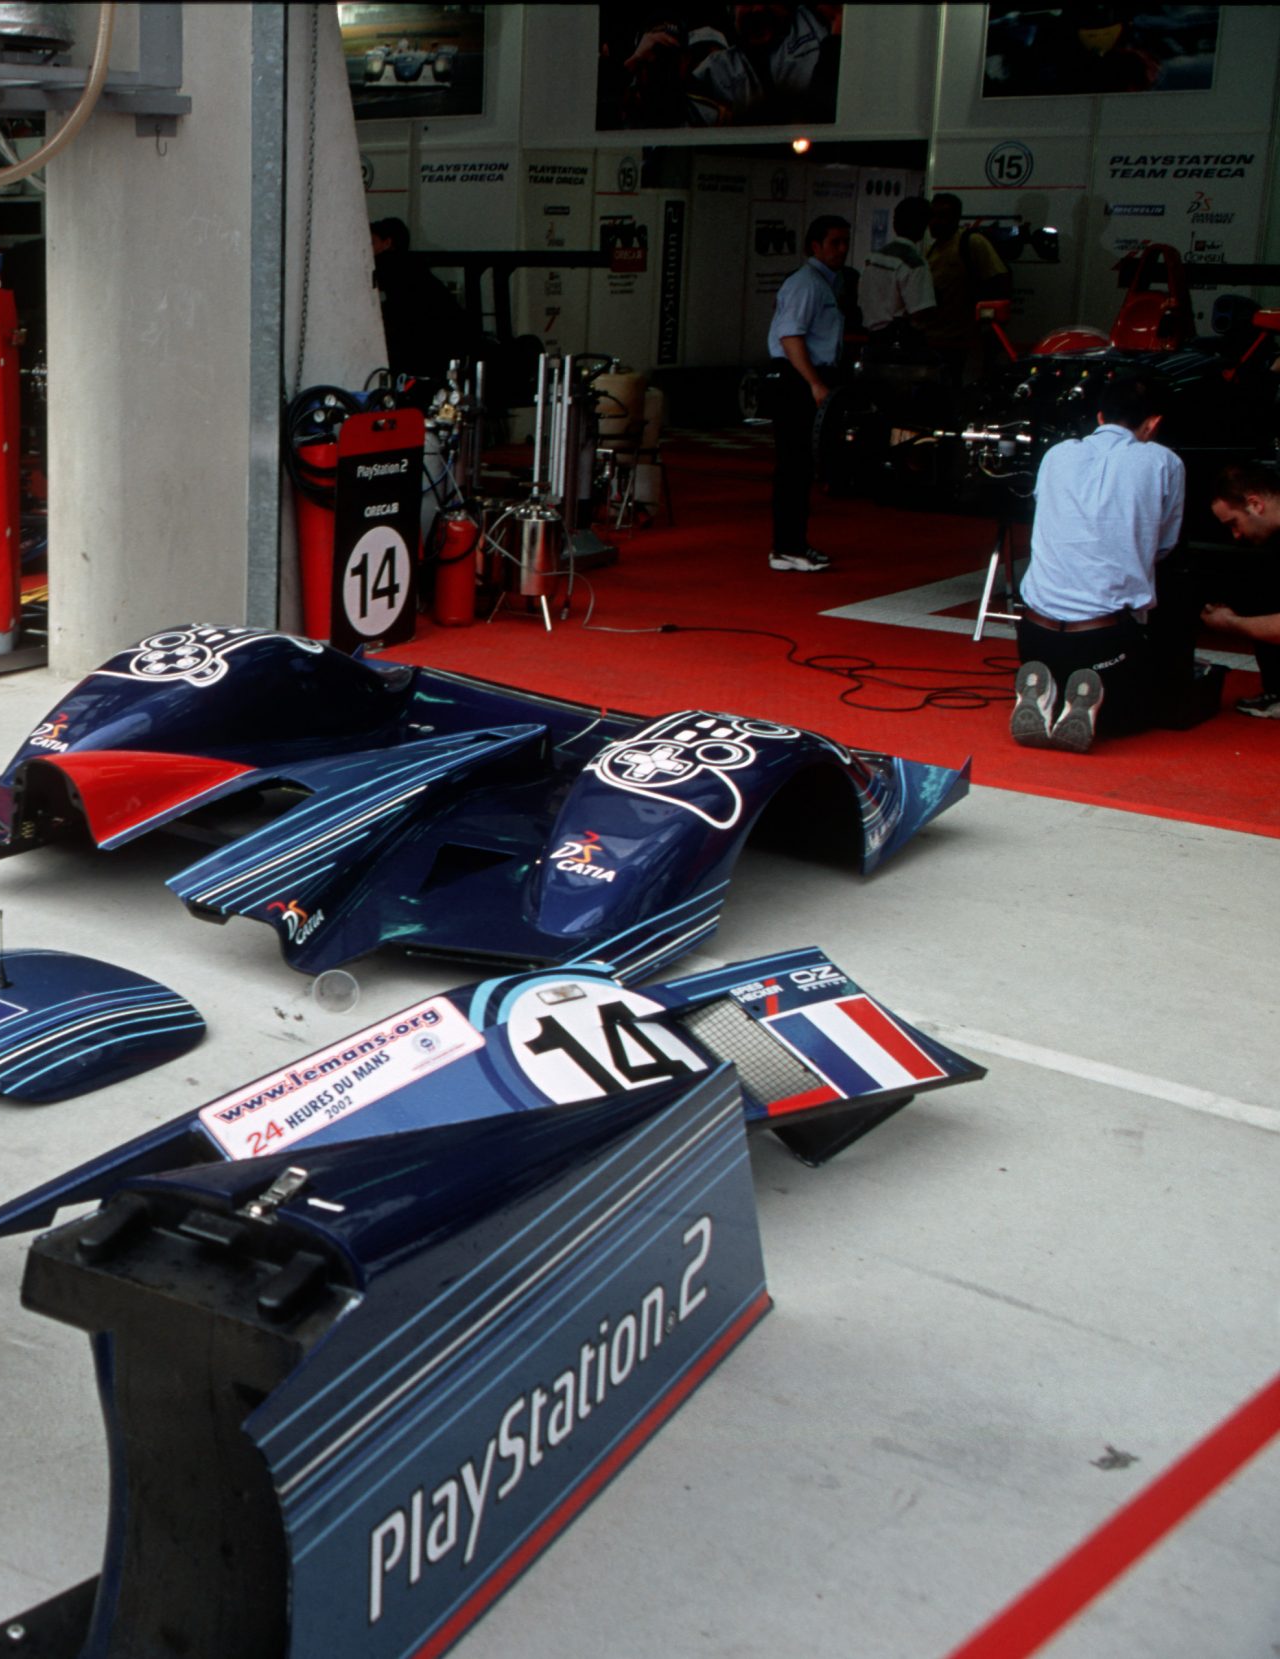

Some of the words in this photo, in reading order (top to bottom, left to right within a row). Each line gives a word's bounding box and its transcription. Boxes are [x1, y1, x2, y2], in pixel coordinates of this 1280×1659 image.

[420, 163, 509, 173] PLAYSTATION
[528, 165, 588, 175] PLAYSTATION
[994, 155, 1023, 179] 15
[1109, 154, 1255, 166] PLAYSTATION
[421, 174, 458, 182] TEAM
[460, 174, 505, 182] ORECA
[528, 176, 554, 185] TEAM
[620, 167, 634, 187] 15
[1109, 168, 1167, 178] TEAM
[1173, 168, 1246, 178] ORECA
[356, 463, 399, 480] PlayStation
[400, 458, 409, 473] 2
[363, 503, 392, 518] ORECA
[350, 546, 400, 619] 14
[29, 736, 69, 753] CATIA
[556, 859, 617, 883] CATIA
[295, 908, 325, 945] CATIA
[523, 1000, 696, 1096] 14
[216, 1006, 442, 1124] www.lemans.org
[246, 1120, 285, 1155] 24
[285, 1092, 331, 1131] HEURES
[331, 1076, 355, 1099] DU
[354, 1050, 392, 1083] MANS
[324, 1094, 354, 1121] 2002
[368, 1285, 664, 1624] PlayStation
[678, 1215, 713, 1322] 2
